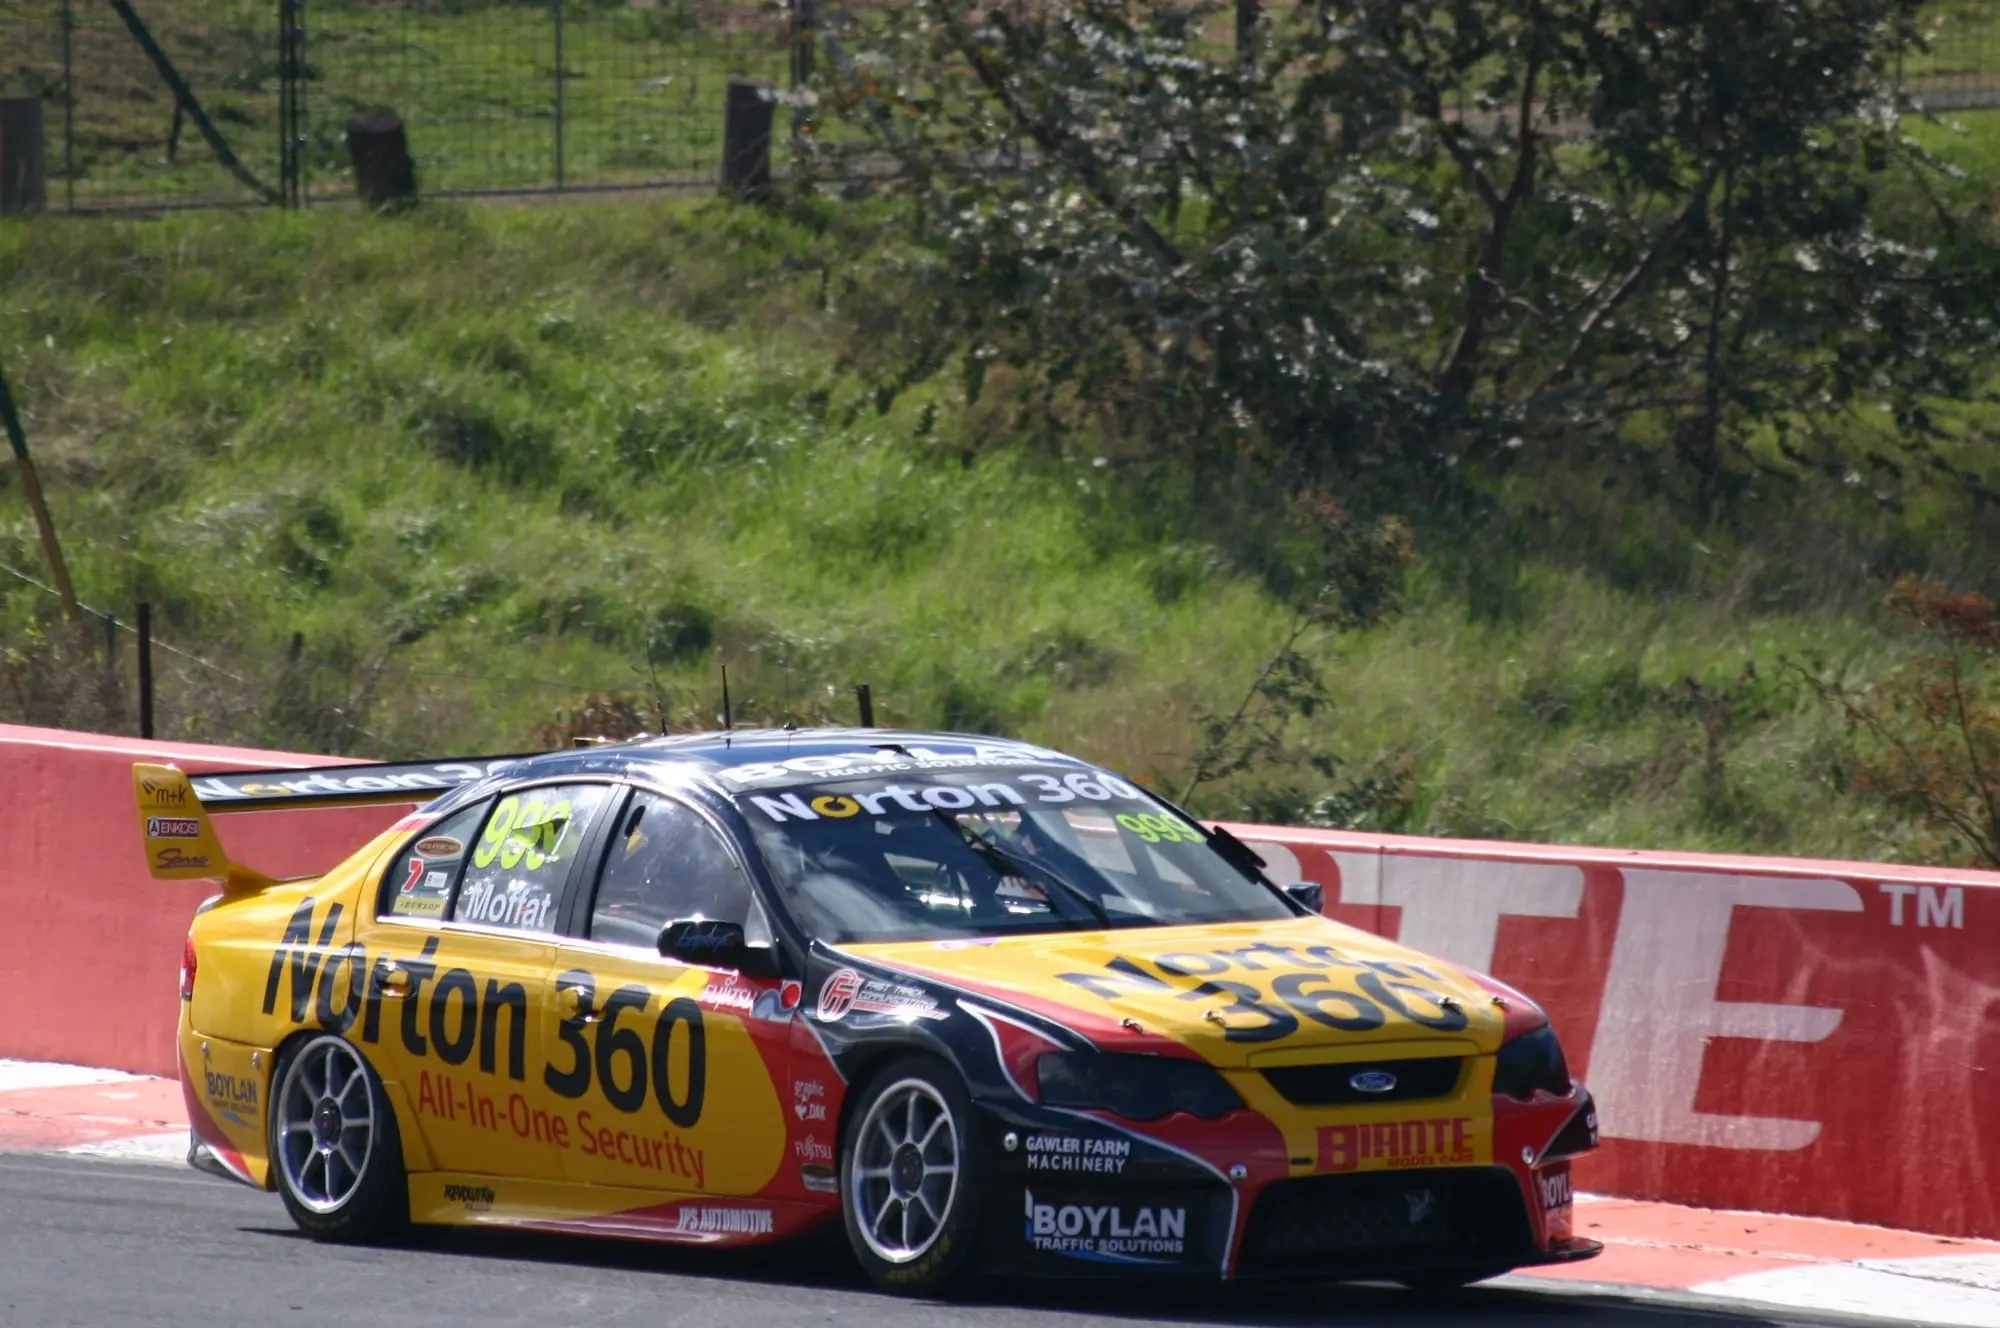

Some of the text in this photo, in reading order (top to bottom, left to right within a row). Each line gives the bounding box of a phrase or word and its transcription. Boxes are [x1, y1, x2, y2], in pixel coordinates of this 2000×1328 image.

[191, 764, 432, 799] Norton
[812, 763, 910, 778] TRAFFIC
[751, 773, 1139, 823] Norton 360
[1115, 813, 1207, 843] 999
[465, 880, 551, 930] Moffat
[263, 896, 707, 1129] Norton 360
[1235, 842, 1864, 1152] TE
[416, 1069, 707, 1190] All-In-One Security
[1026, 1136, 1131, 1156] GAWLER FARM
[1027, 1155, 1126, 1174] MACHINERY
[1032, 1203, 1187, 1238] BOYLAN
[1034, 1236, 1184, 1253] TRAFFIC SOLUTIONS
